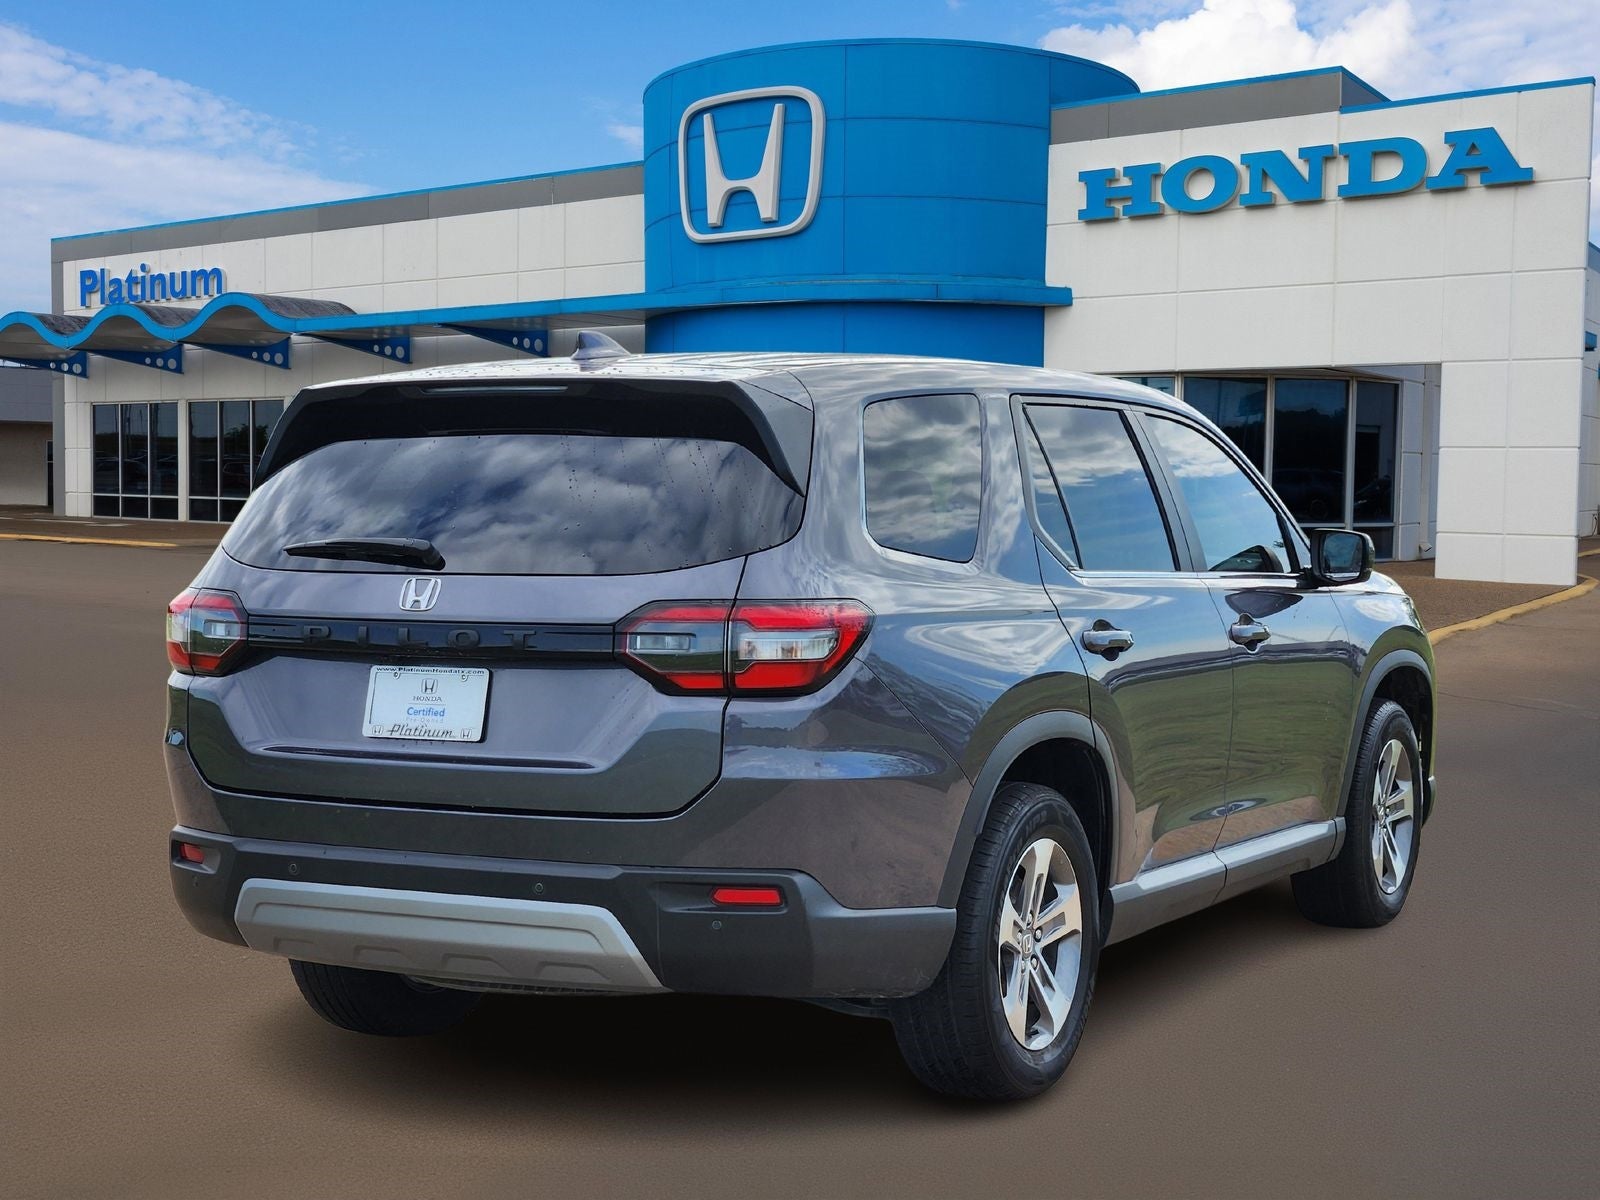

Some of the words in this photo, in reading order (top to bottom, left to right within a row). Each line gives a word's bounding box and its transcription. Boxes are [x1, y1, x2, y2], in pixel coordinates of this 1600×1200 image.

[1077, 126, 1534, 222] HONDA
[79, 263, 226, 308] Platinum
[303, 625, 537, 650] PILOT
[407, 707, 446, 717] Certified
[387, 723, 454, 738] Platinum
